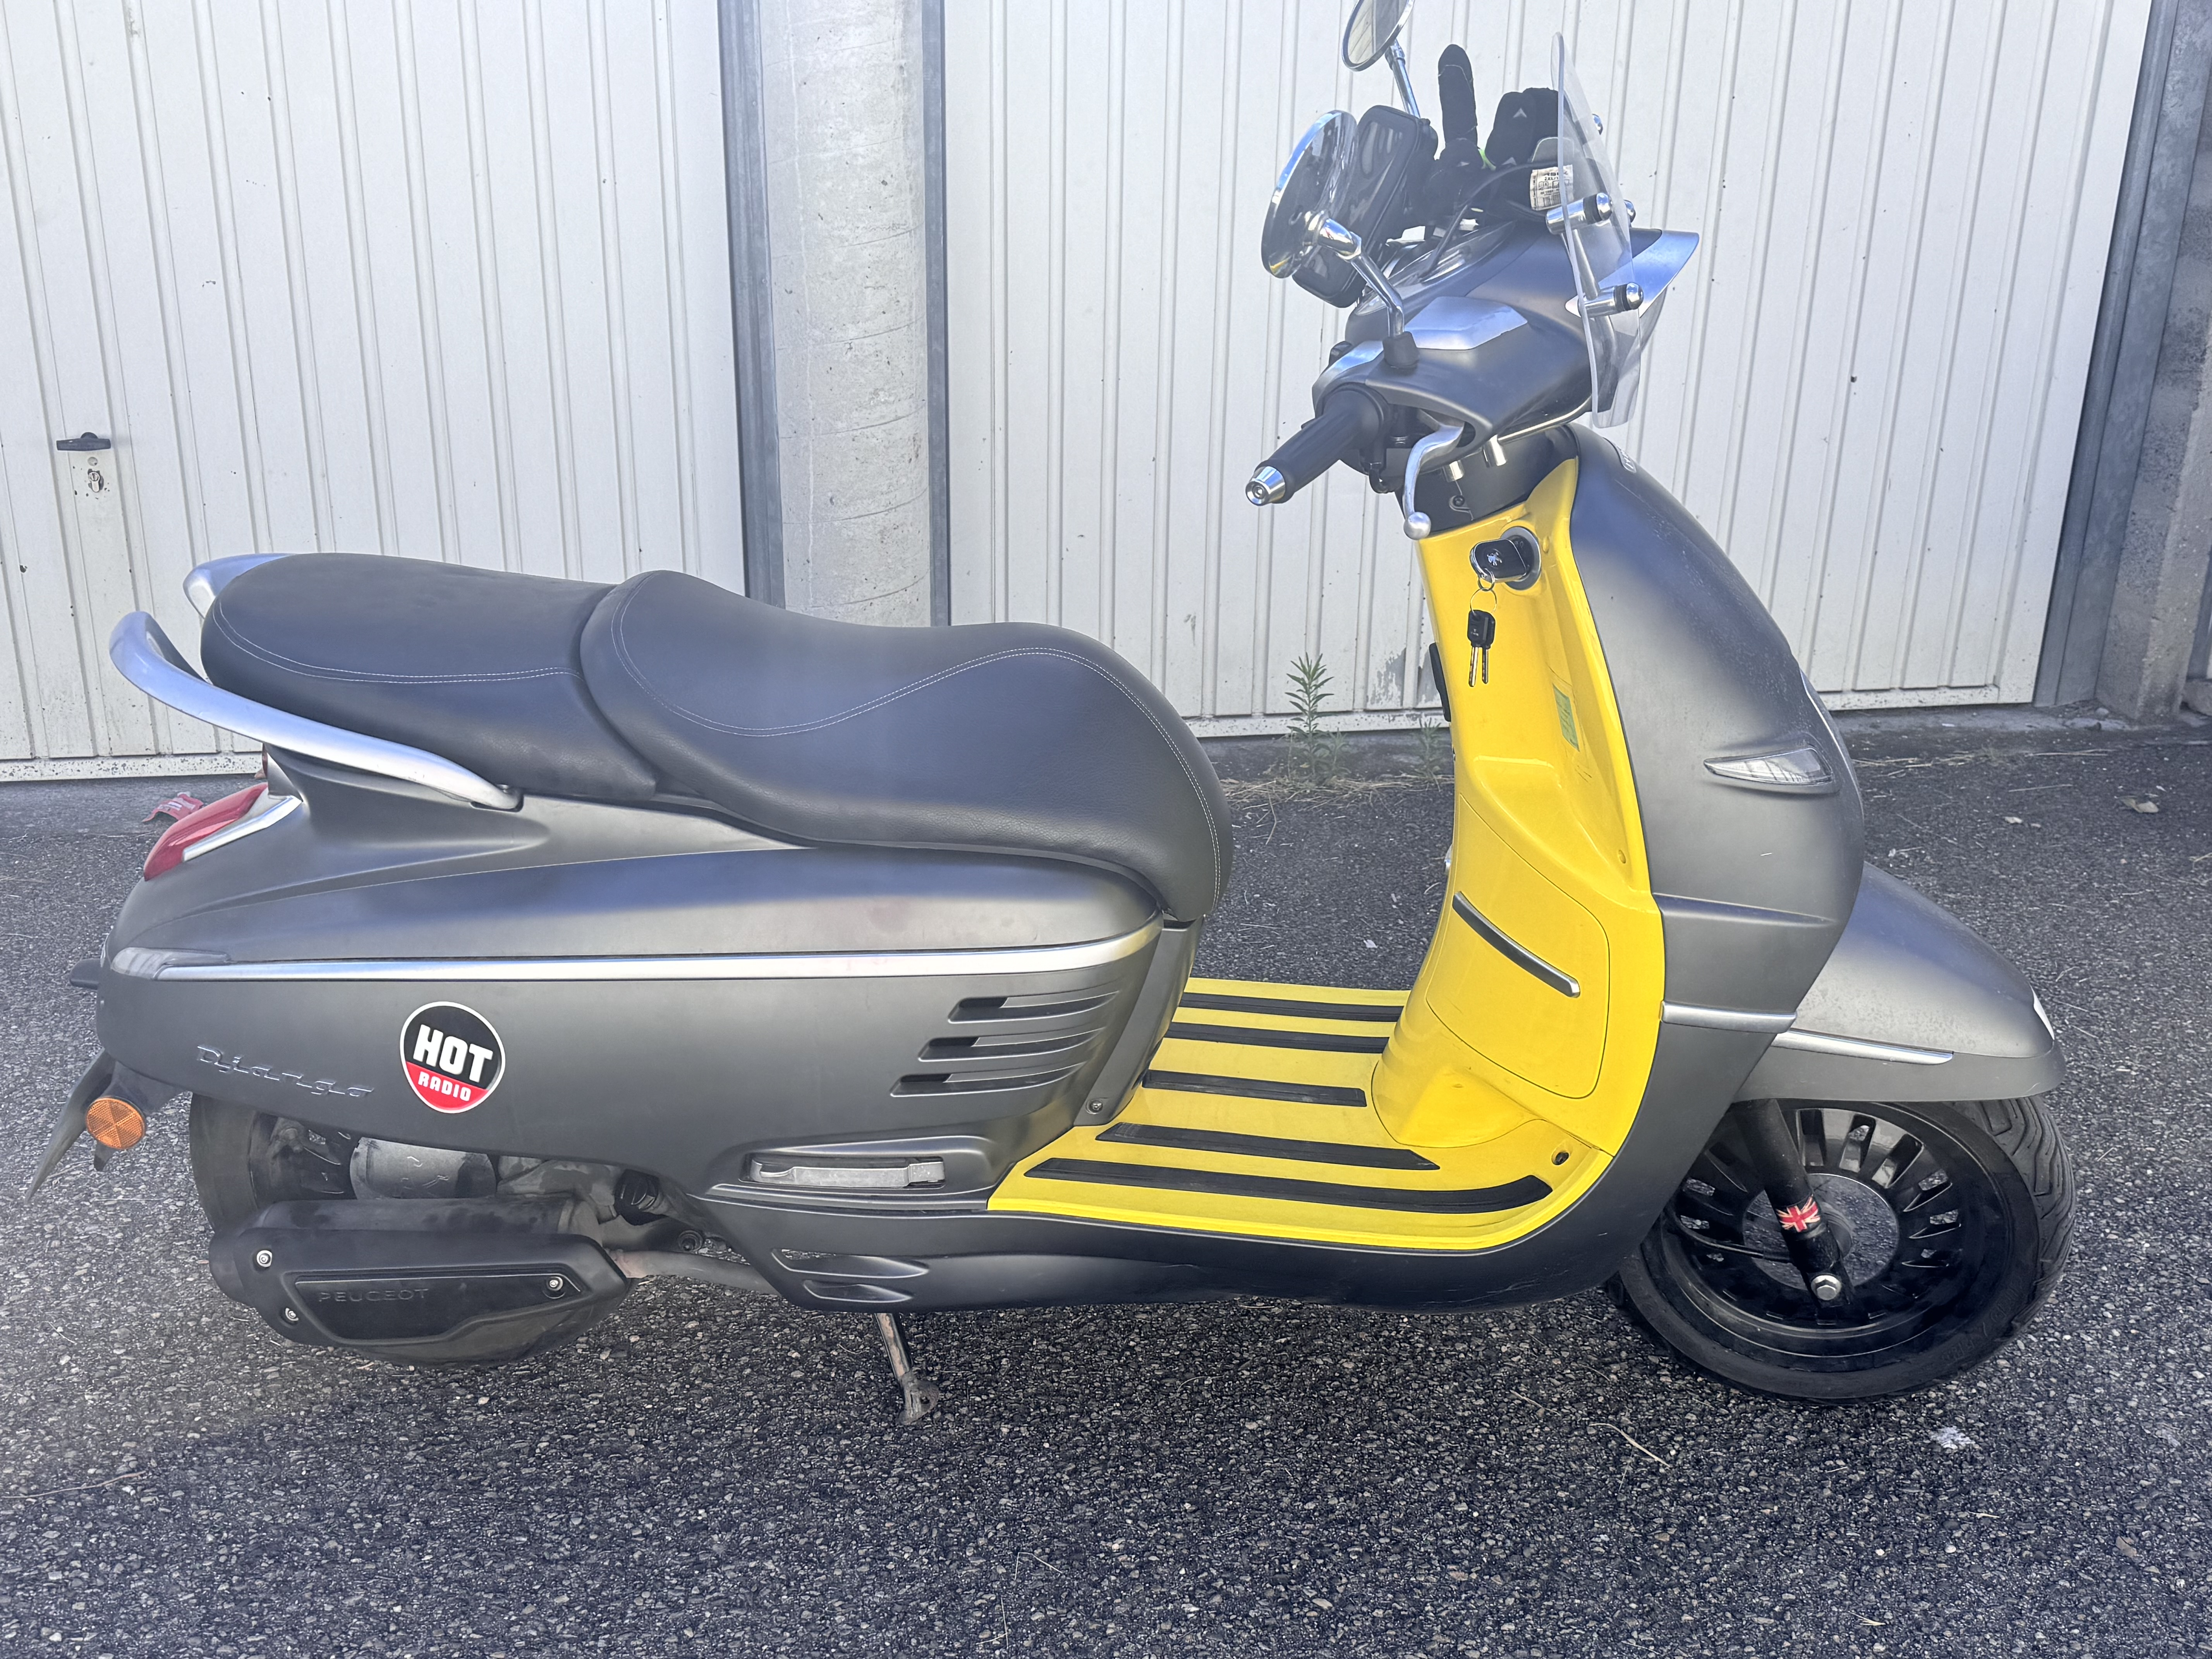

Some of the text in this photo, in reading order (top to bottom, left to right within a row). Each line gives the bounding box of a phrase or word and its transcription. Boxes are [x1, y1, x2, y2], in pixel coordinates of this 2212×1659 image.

[197, 1045, 374, 1097] Django
[413, 1024, 493, 1083] HOT
[418, 1071, 471, 1101] RADIO
[319, 1288, 429, 1302] PEUGEOT
